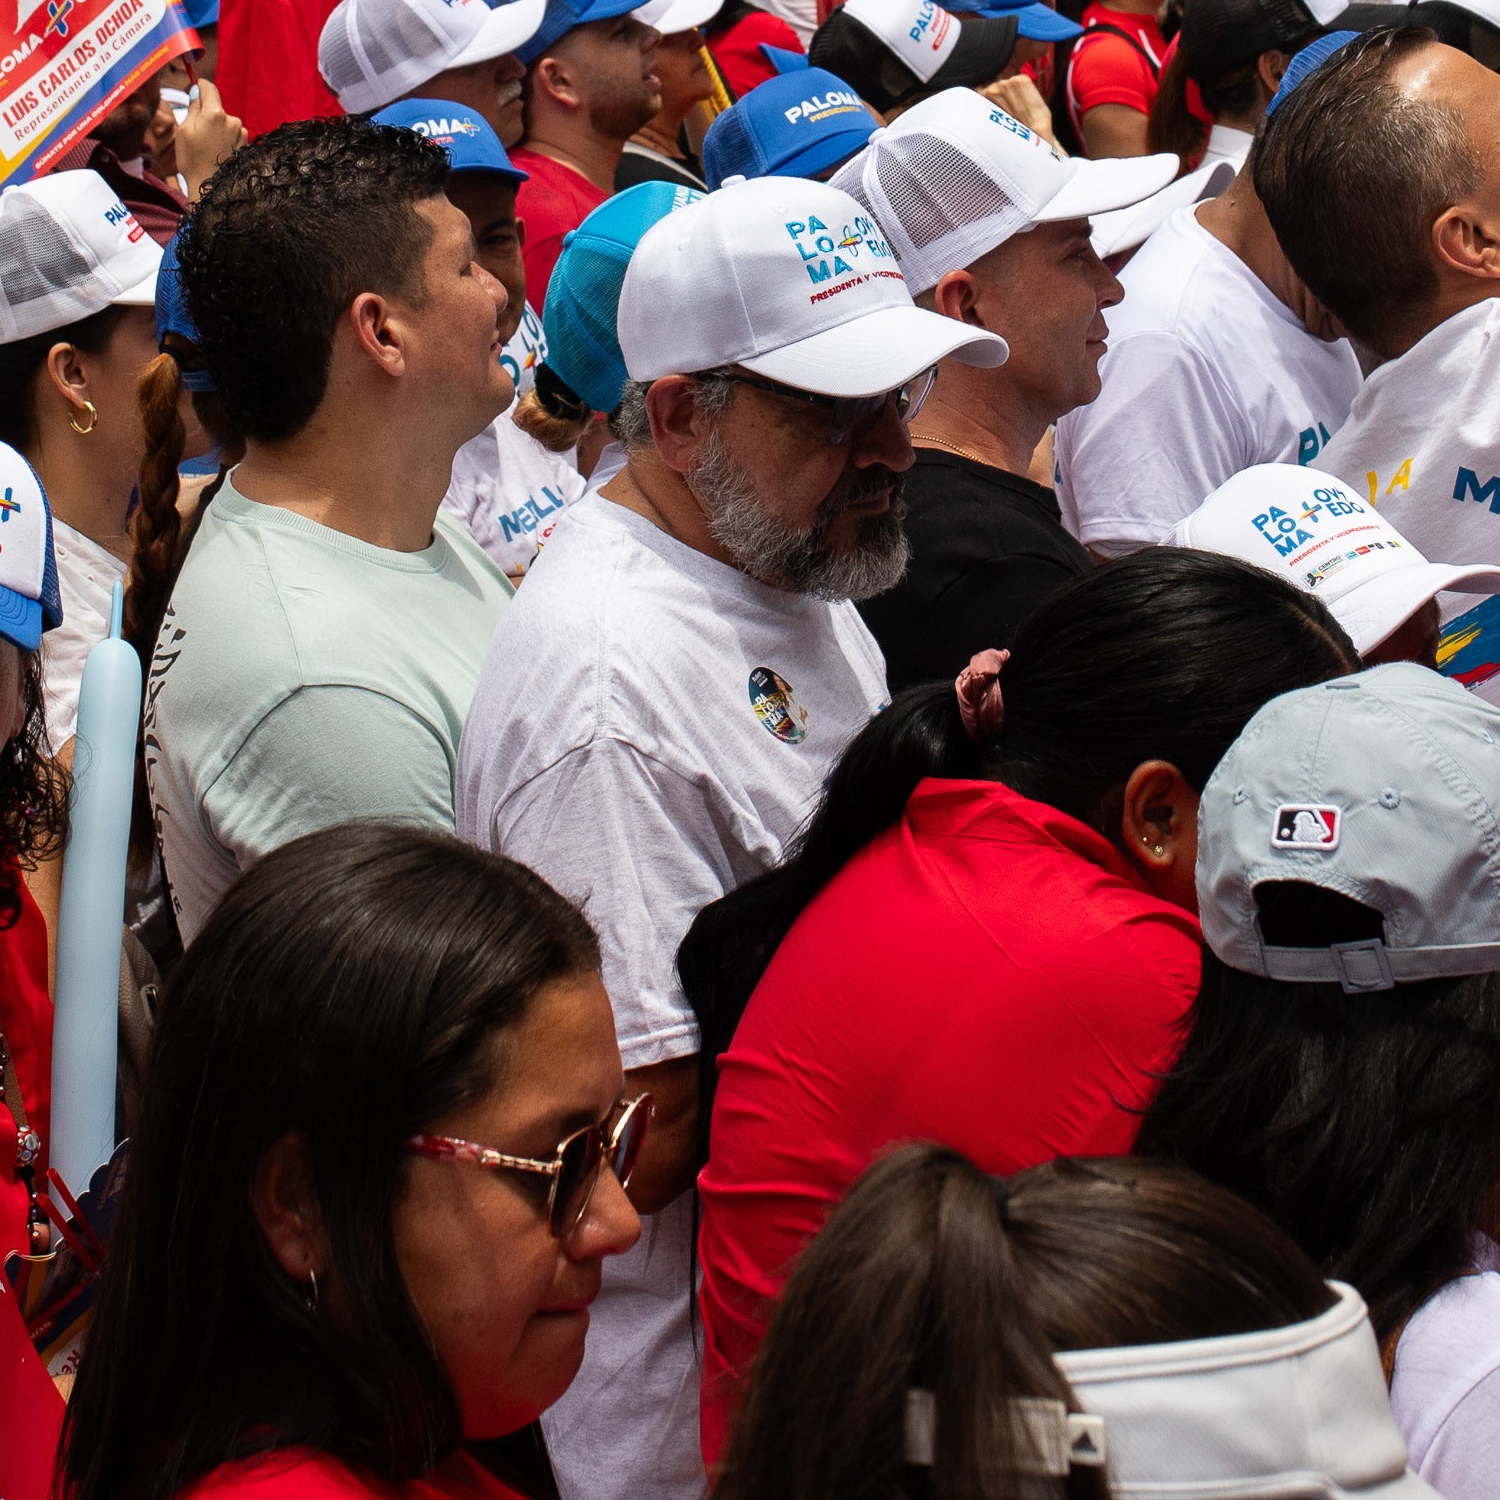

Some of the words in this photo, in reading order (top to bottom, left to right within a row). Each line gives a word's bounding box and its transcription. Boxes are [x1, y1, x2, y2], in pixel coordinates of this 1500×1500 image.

[2, 90, 40, 129] LUIS
[37, 39, 98, 99] CARLOS
[14, 70, 92, 141] Representante
[93, 60, 101, 72] a
[100, 50, 112, 64] la
[111, 12, 152, 50] Cámara
[76, 114, 92, 131] UNA
[91, 84, 126, 118] COLOMBIA
[784, 90, 864, 124] PALOMA
[785, 215, 828, 240] PA
[796, 235, 834, 261] LO
[806, 256, 853, 284] MA
[810, 276, 862, 304] PRESIDENTA
[1251, 506, 1287, 532] PA
[1263, 518, 1296, 545] LO
[1327, 501, 1365, 517] EDO
[1274, 529, 1315, 558] MA
[1289, 539, 1330, 567] PRESIDENTA
[1318, 555, 1342, 571] CENTRO
